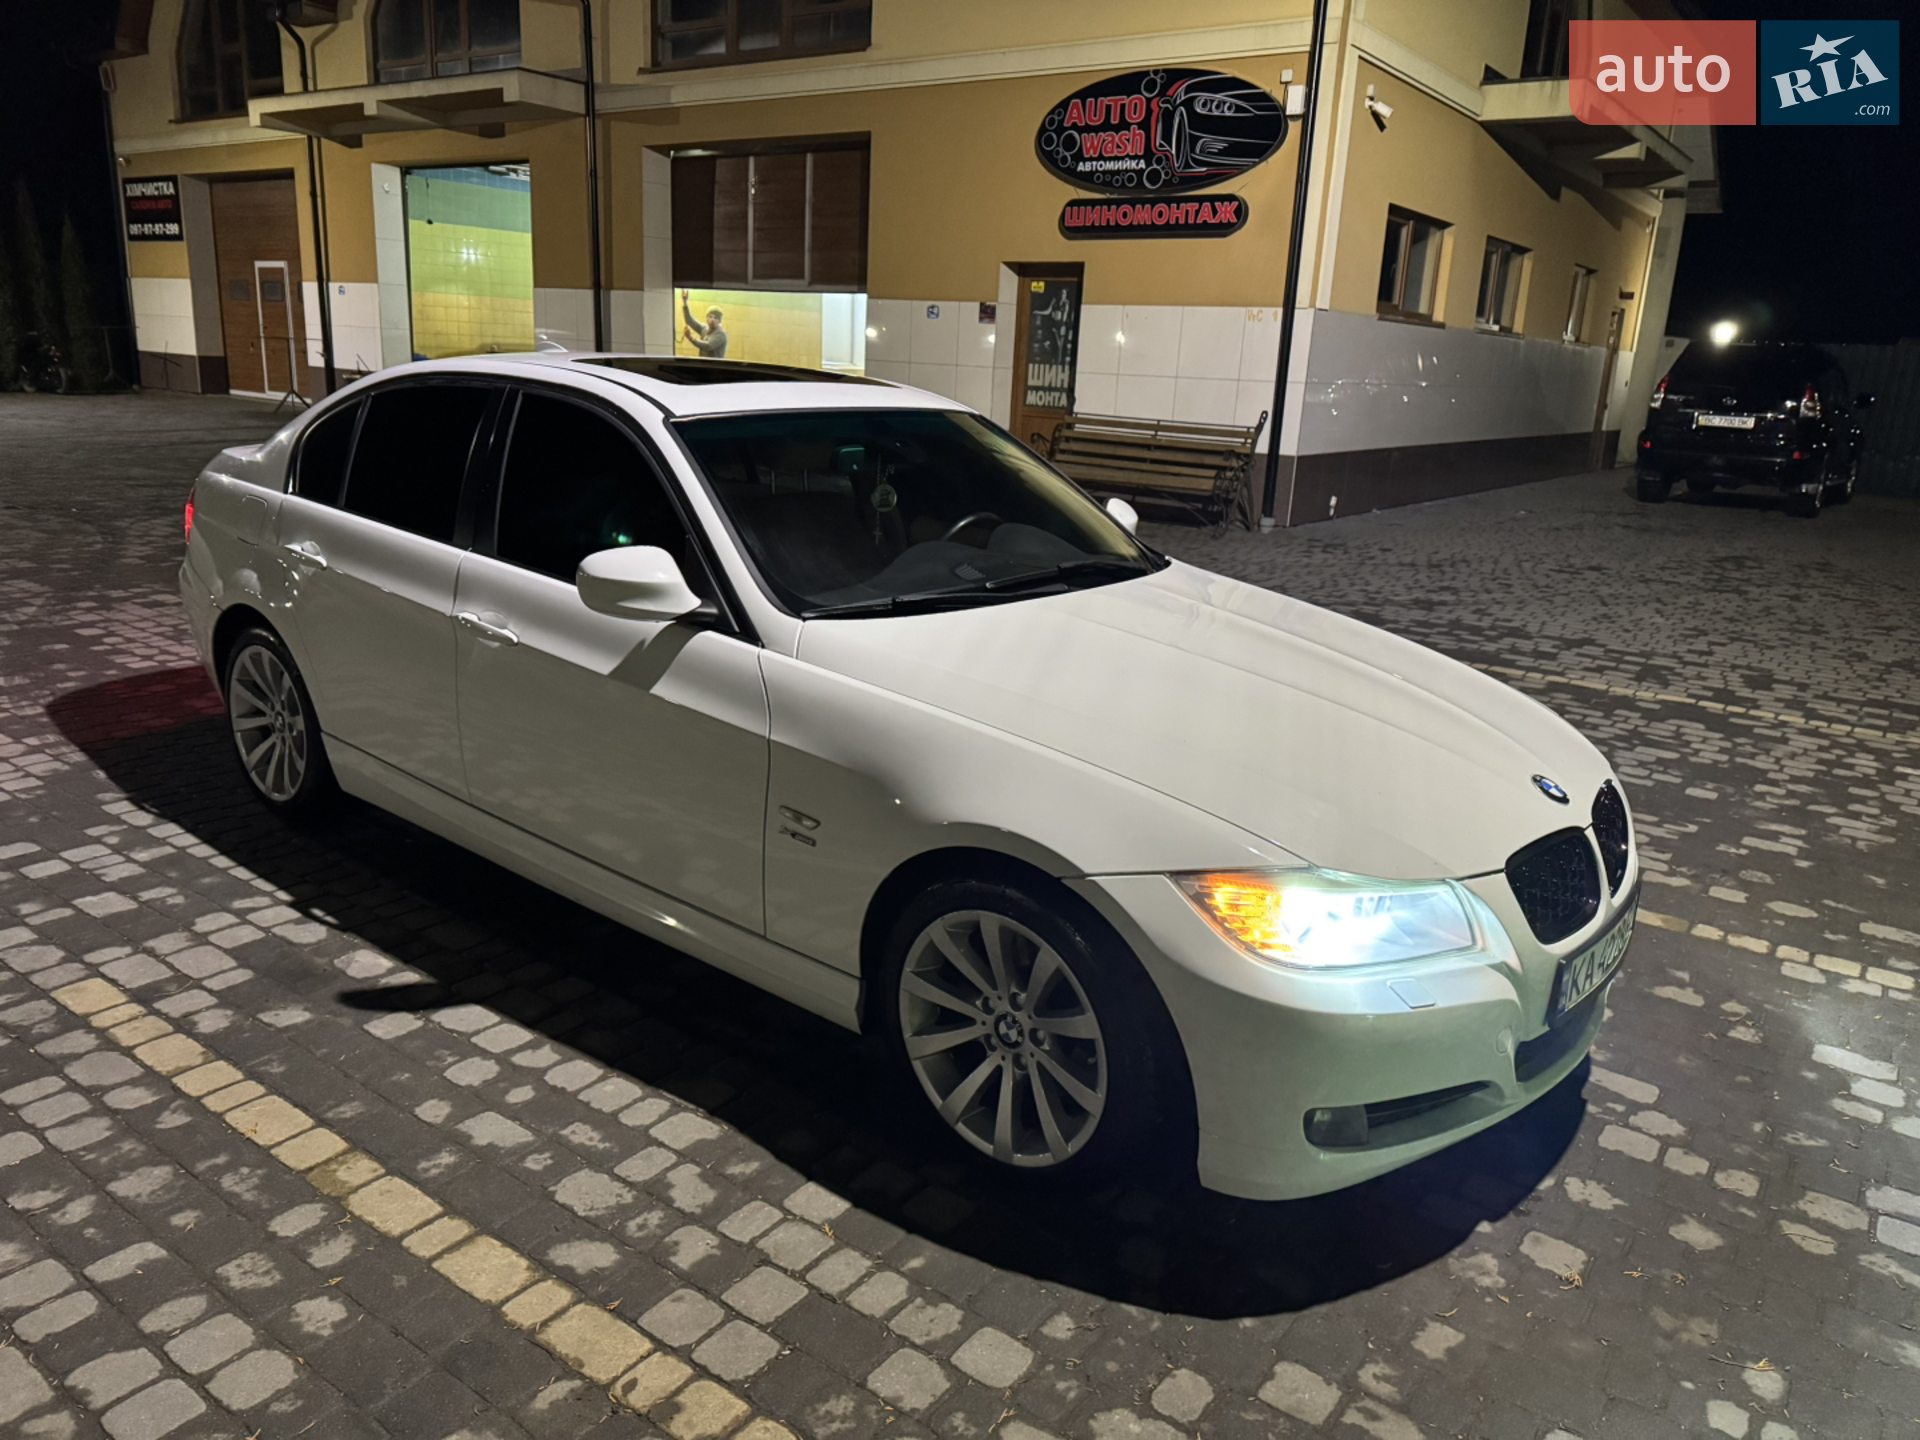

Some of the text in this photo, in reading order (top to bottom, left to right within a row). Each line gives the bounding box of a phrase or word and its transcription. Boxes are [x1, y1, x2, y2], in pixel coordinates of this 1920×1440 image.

[1064, 95, 1147, 126] AUTO
[1082, 125, 1145, 158] wash
[1076, 157, 1146, 172] АВТОМИЙКА
[1064, 201, 1239, 227] ШИНОМОНТАЖ
[1568, 950, 1595, 1003] KA
